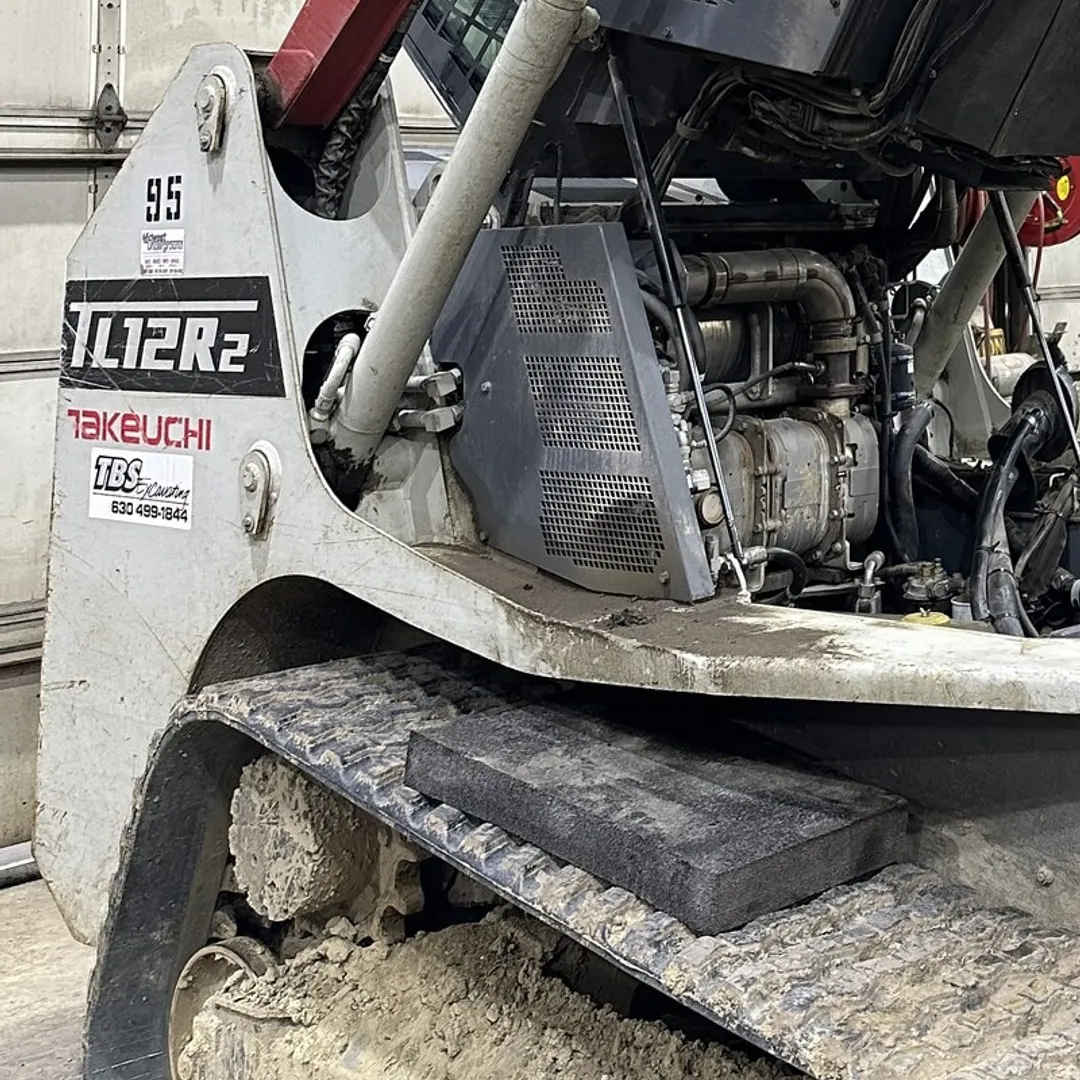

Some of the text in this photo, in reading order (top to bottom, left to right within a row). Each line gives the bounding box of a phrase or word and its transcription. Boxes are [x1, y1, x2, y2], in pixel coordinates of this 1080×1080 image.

[146, 175, 182, 222] 95
[69, 300, 259, 373] TL12R2
[93, 455, 143, 493] TBS
[111, 500, 188, 523] 630 499-1844
